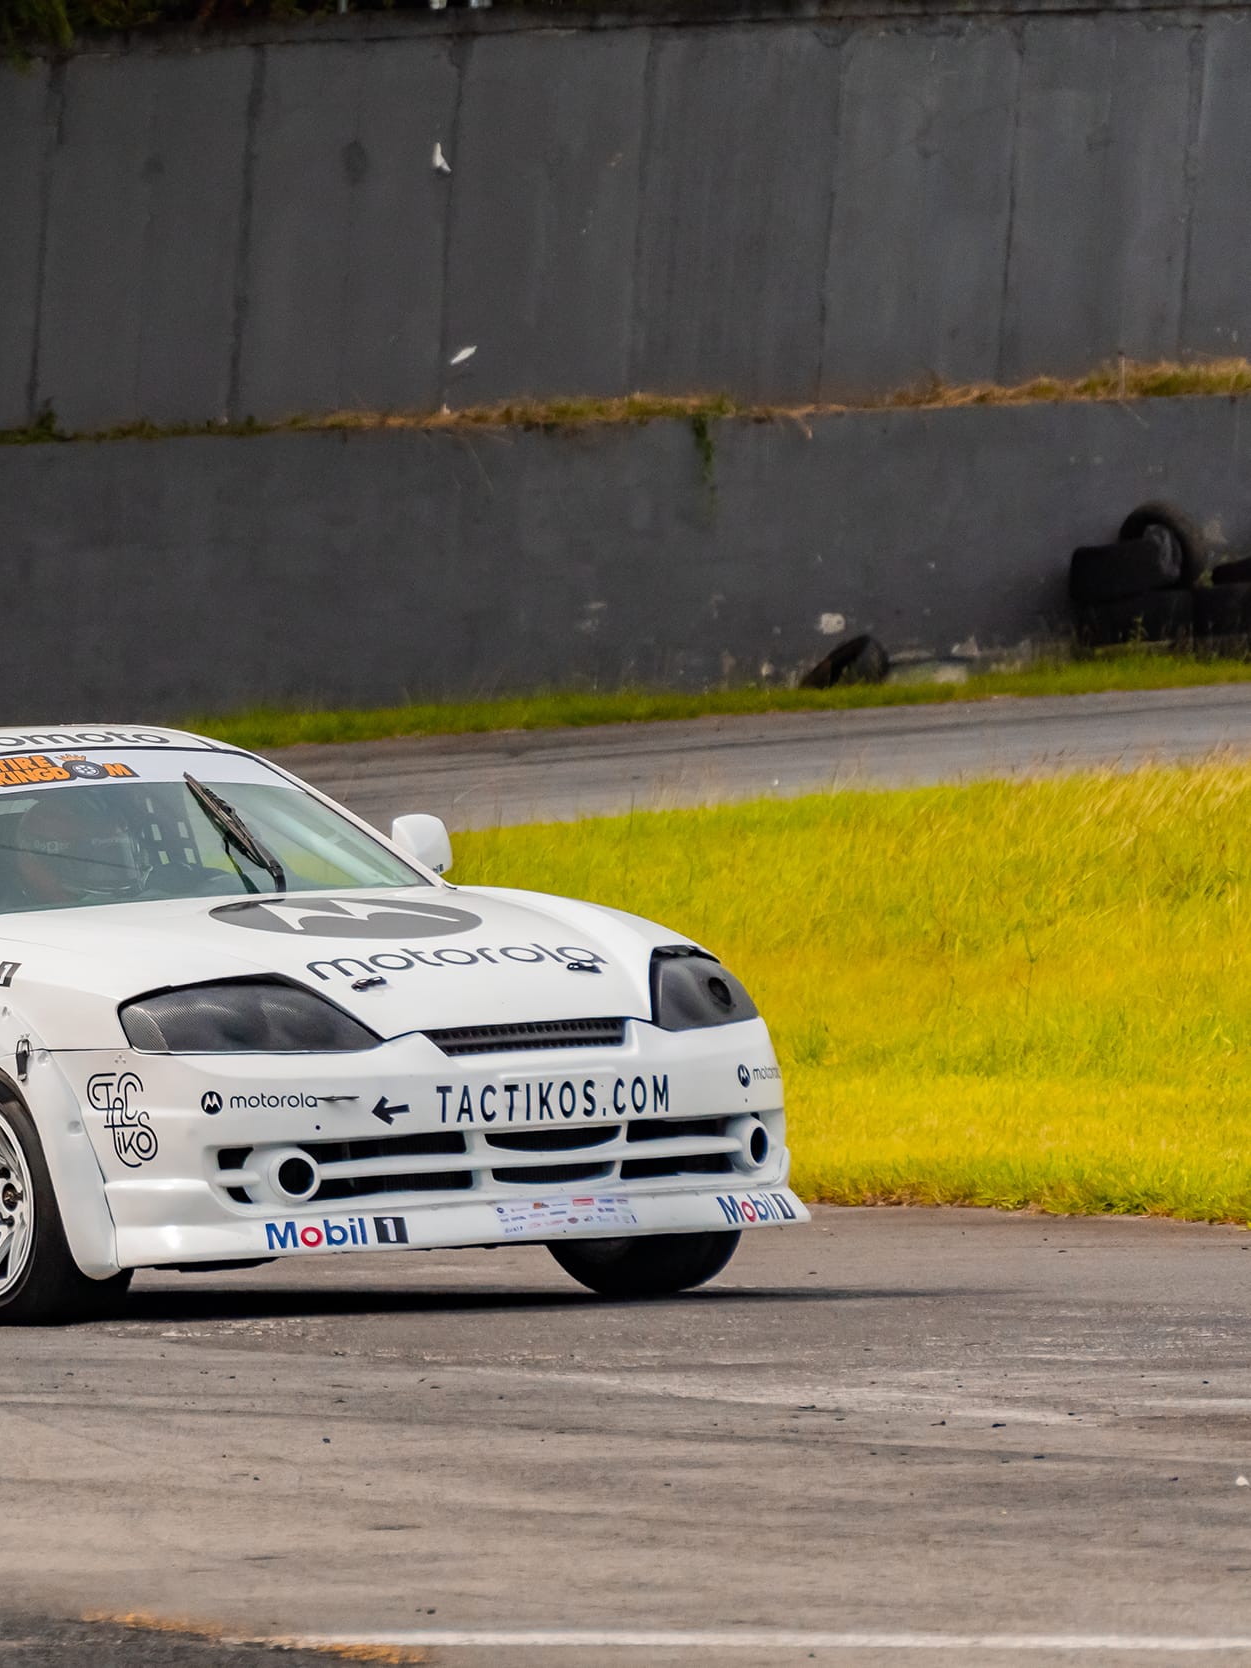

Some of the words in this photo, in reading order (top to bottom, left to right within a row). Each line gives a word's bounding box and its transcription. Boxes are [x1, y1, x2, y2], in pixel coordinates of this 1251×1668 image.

[306, 943, 610, 981] motorola
[230, 1093, 318, 1109] motorola
[436, 1075, 670, 1123] TACTIKOS.COM
[716, 1192, 780, 1224] Mobil
[265, 1218, 368, 1250] Mobil
[378, 1217, 406, 1244] 1
